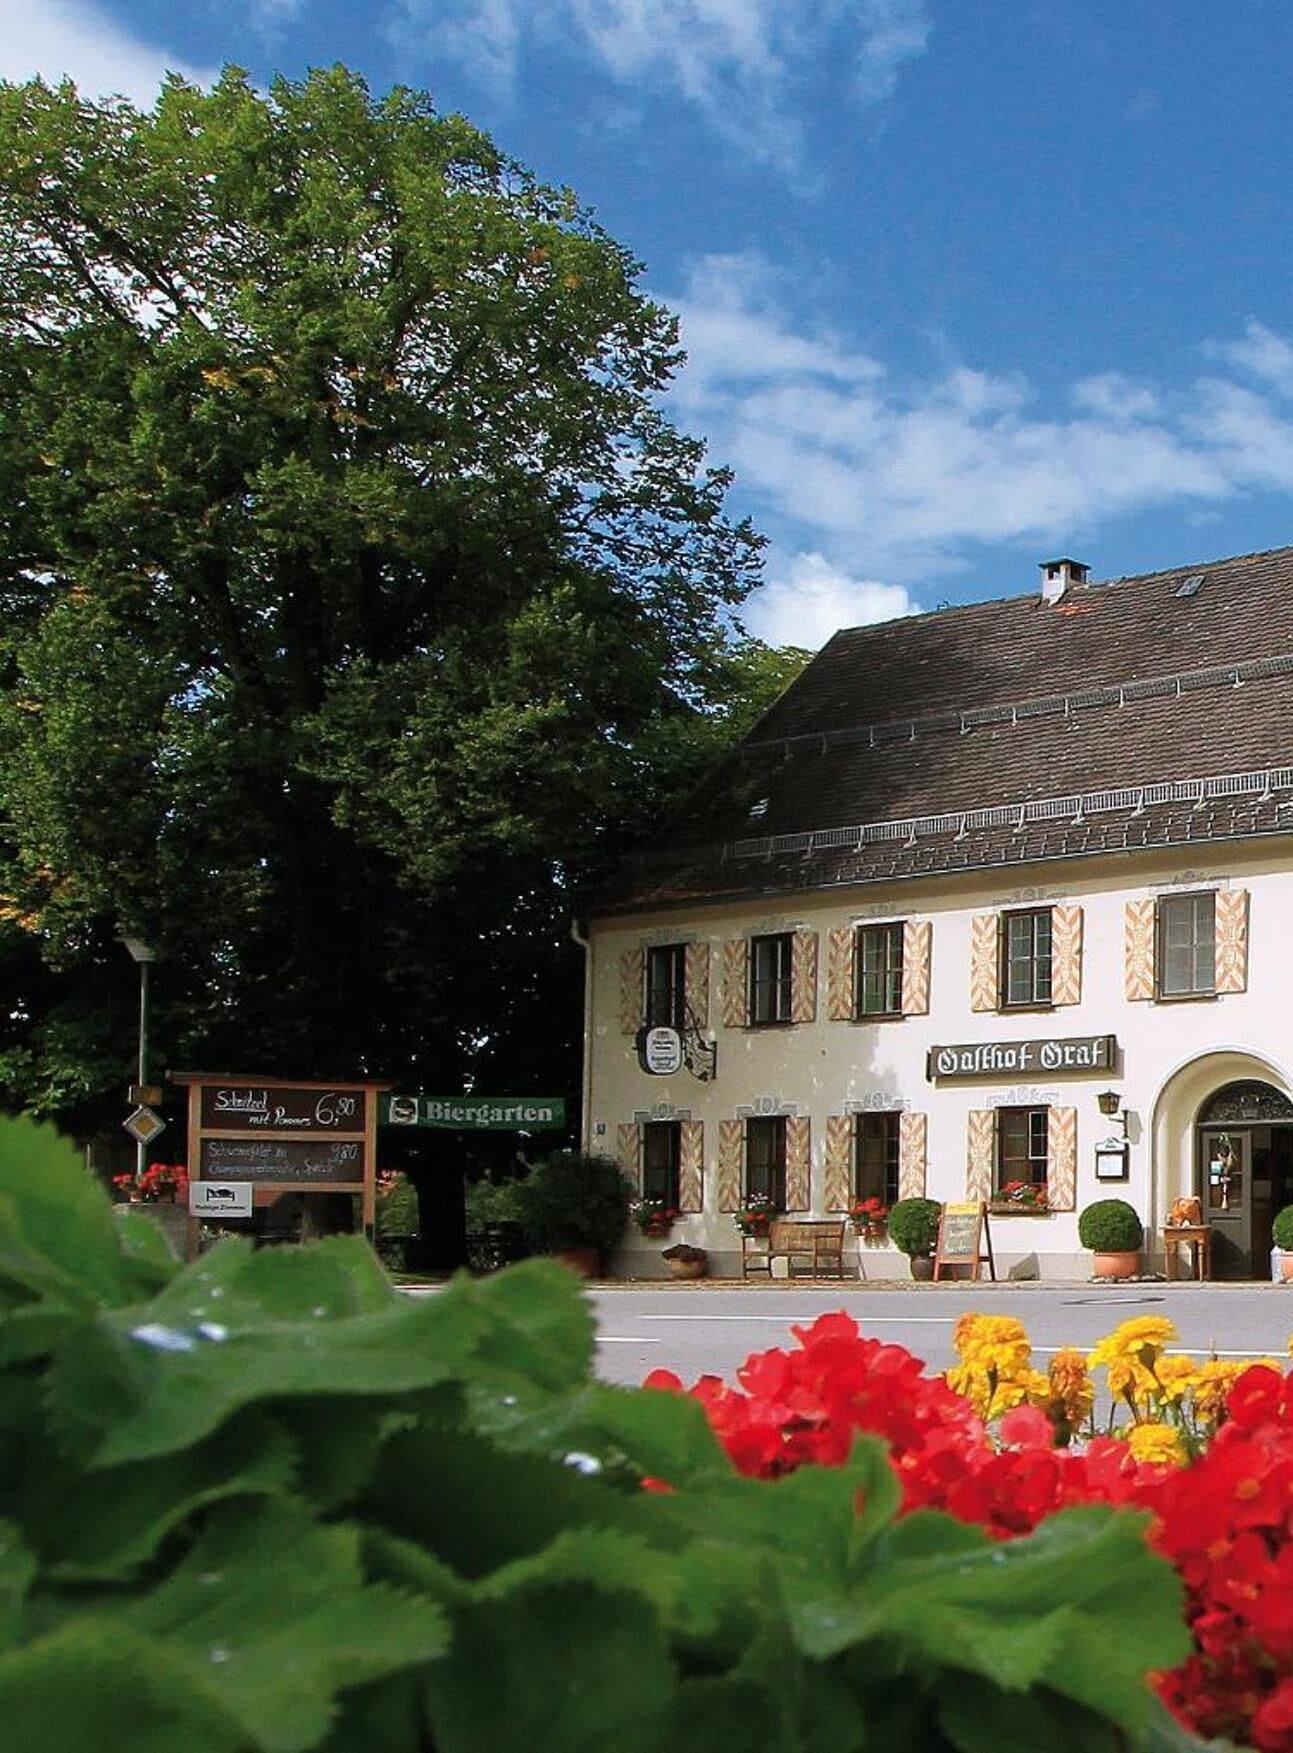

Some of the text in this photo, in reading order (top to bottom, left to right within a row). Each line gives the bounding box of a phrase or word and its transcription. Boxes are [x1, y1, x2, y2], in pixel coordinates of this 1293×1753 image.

[937, 1037, 1105, 1075] Gasthof Graf
[426, 1101, 553, 1127] Biergarten
